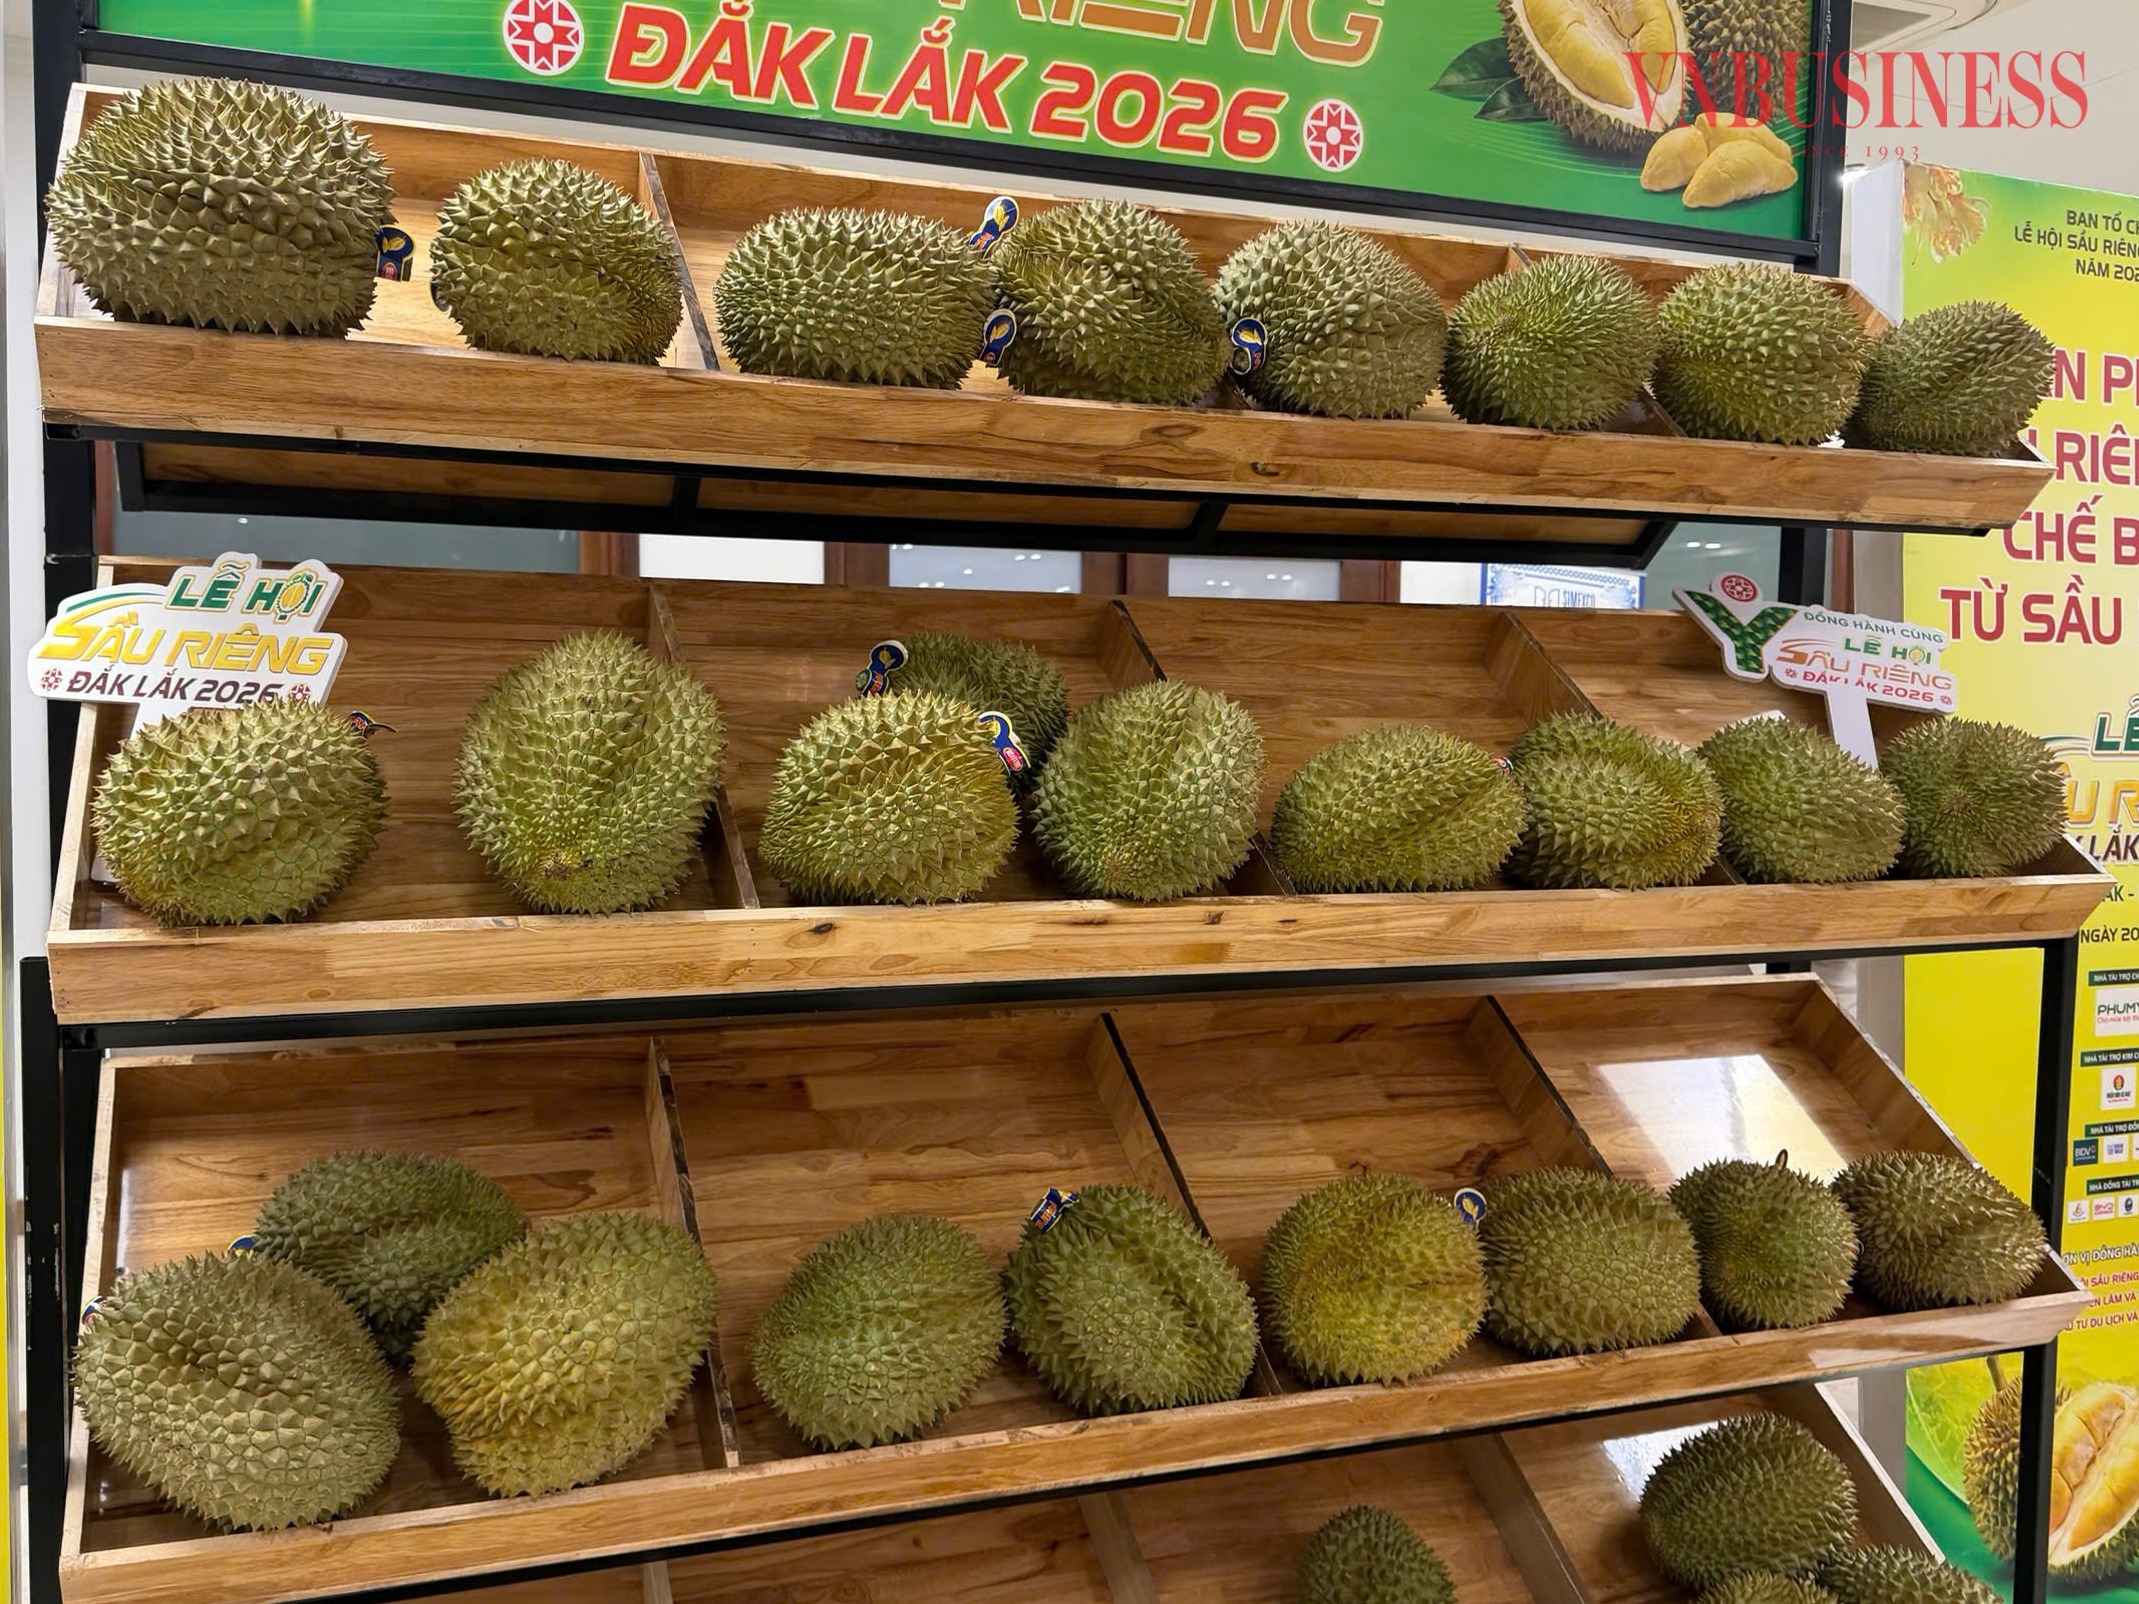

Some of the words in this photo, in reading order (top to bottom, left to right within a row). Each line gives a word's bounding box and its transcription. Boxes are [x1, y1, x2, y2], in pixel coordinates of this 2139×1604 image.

[606, 0, 834, 110] ĐẮK
[832, 16, 1028, 133] LẮK
[1029, 61, 1288, 163] 2026
[2014, 220, 2033, 243] LỄ
[2037, 227, 2062, 250] HỘI
[2067, 229, 2098, 252] SẦU
[2102, 238, 2139, 259] RIÊN
[2066, 209, 2098, 229] BAN
[2102, 210, 2122, 232] TỐ
[2075, 257, 2110, 278] NĂM
[2003, 494, 2103, 564] CHẾ
[167, 560, 248, 609] LỄ
[245, 572, 323, 622] HỘI
[1940, 576, 2009, 642] TỪ
[2021, 573, 2122, 645] SẦU
[36, 606, 166, 666] SẦU
[164, 622, 335, 677] RIÊNG
[1804, 611, 1849, 629] ĐỒNG
[1853, 619, 1897, 637] HÀNH
[1900, 625, 1944, 645] CÙNG
[1776, 642, 1851, 674] SẦU
[1861, 662, 1953, 691] RIÊNG
[1843, 633, 1883, 656] LỄ
[1891, 645, 1933, 667] HỘI
[66, 664, 135, 697] ĐẮK
[131, 667, 197, 700] LẮK
[194, 679, 285, 705] 2026
[1882, 684, 1935, 703] 2026
[2080, 924, 2118, 943] NGÀY
[2092, 1244, 2121, 1262] ĐỒNG
